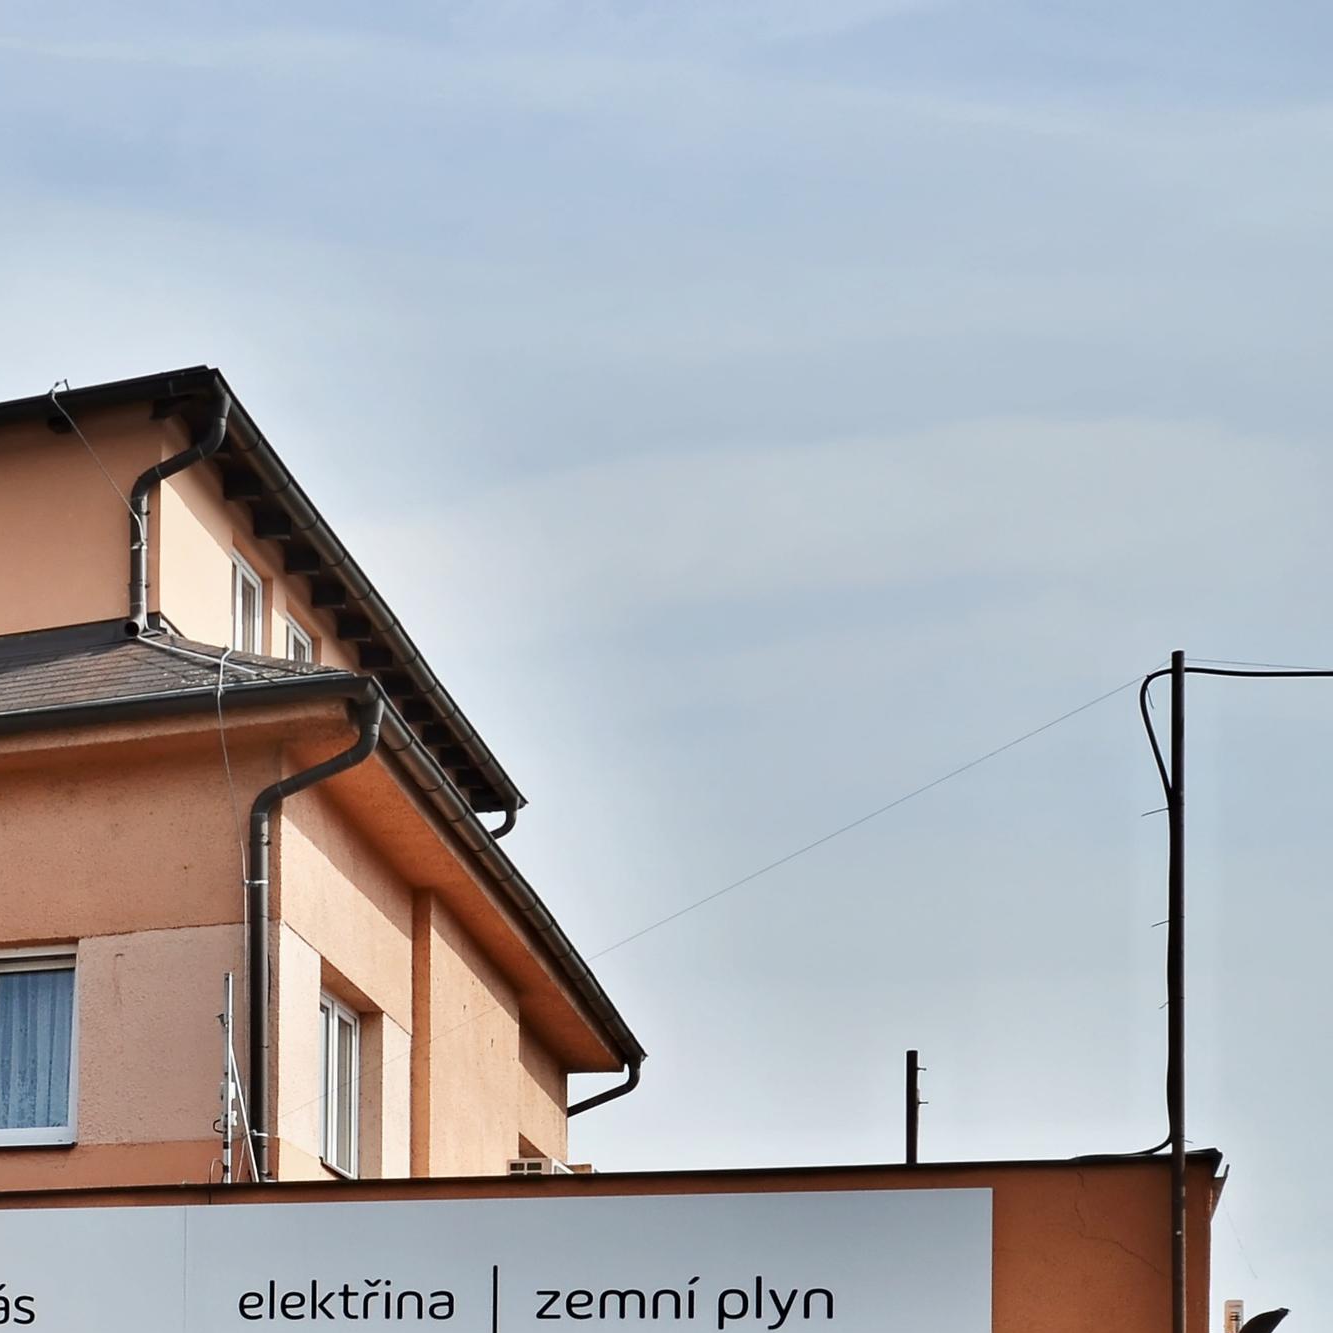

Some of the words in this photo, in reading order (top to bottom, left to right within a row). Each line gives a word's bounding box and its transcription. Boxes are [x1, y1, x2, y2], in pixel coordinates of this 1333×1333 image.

[238, 1279, 455, 1321] elektřina
[536, 1276, 700, 1320] zemní
[718, 1276, 834, 1330] plyn
